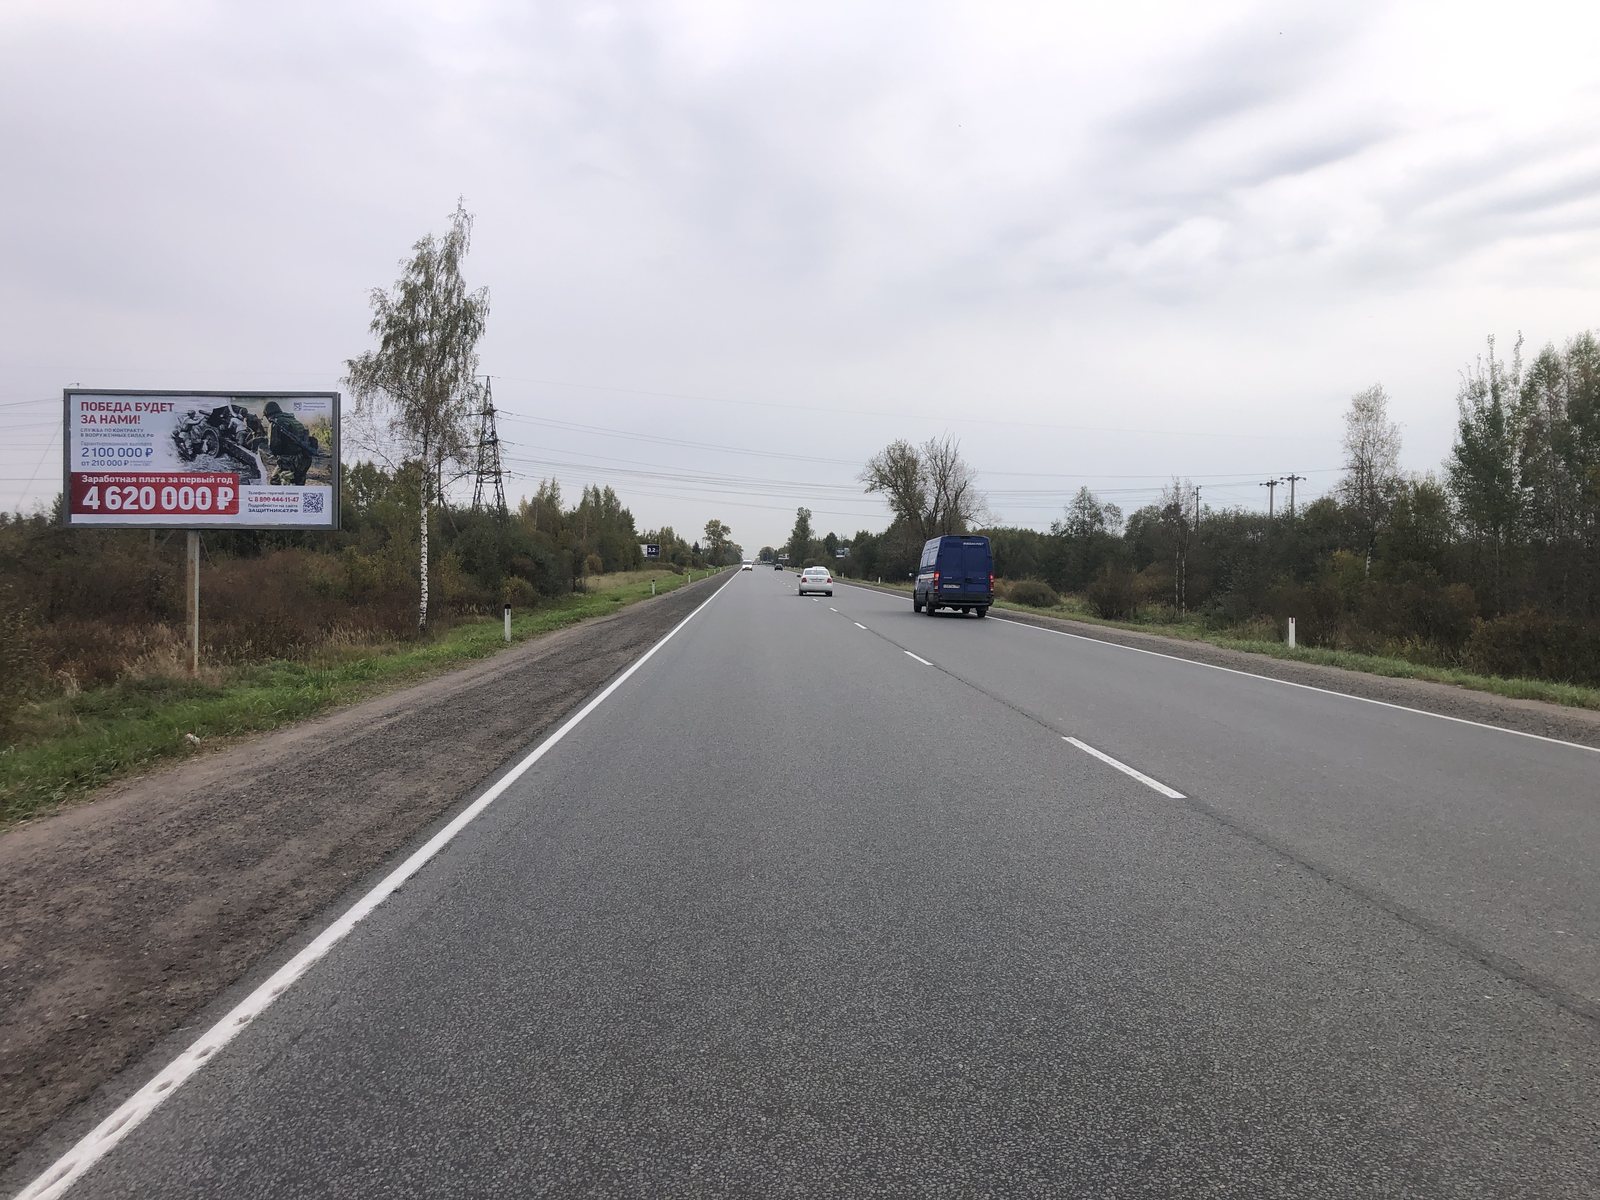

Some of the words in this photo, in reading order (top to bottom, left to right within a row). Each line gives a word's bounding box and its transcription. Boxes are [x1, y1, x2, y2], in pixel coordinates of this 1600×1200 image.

[81, 401, 132, 413] ПОБЕДА
[135, 402, 175, 413] БУДЕТ
[81, 414, 97, 424] ЗА
[100, 414, 141, 425] НАМИ!
[117, 447, 142, 458] 000
[82, 475, 136, 484] Заработная
[180, 475, 215, 484] первый
[216, 476, 234, 484] год
[82, 486, 100, 510] 4
[105, 486, 156, 510] 620
[161, 486, 212, 511] 000
